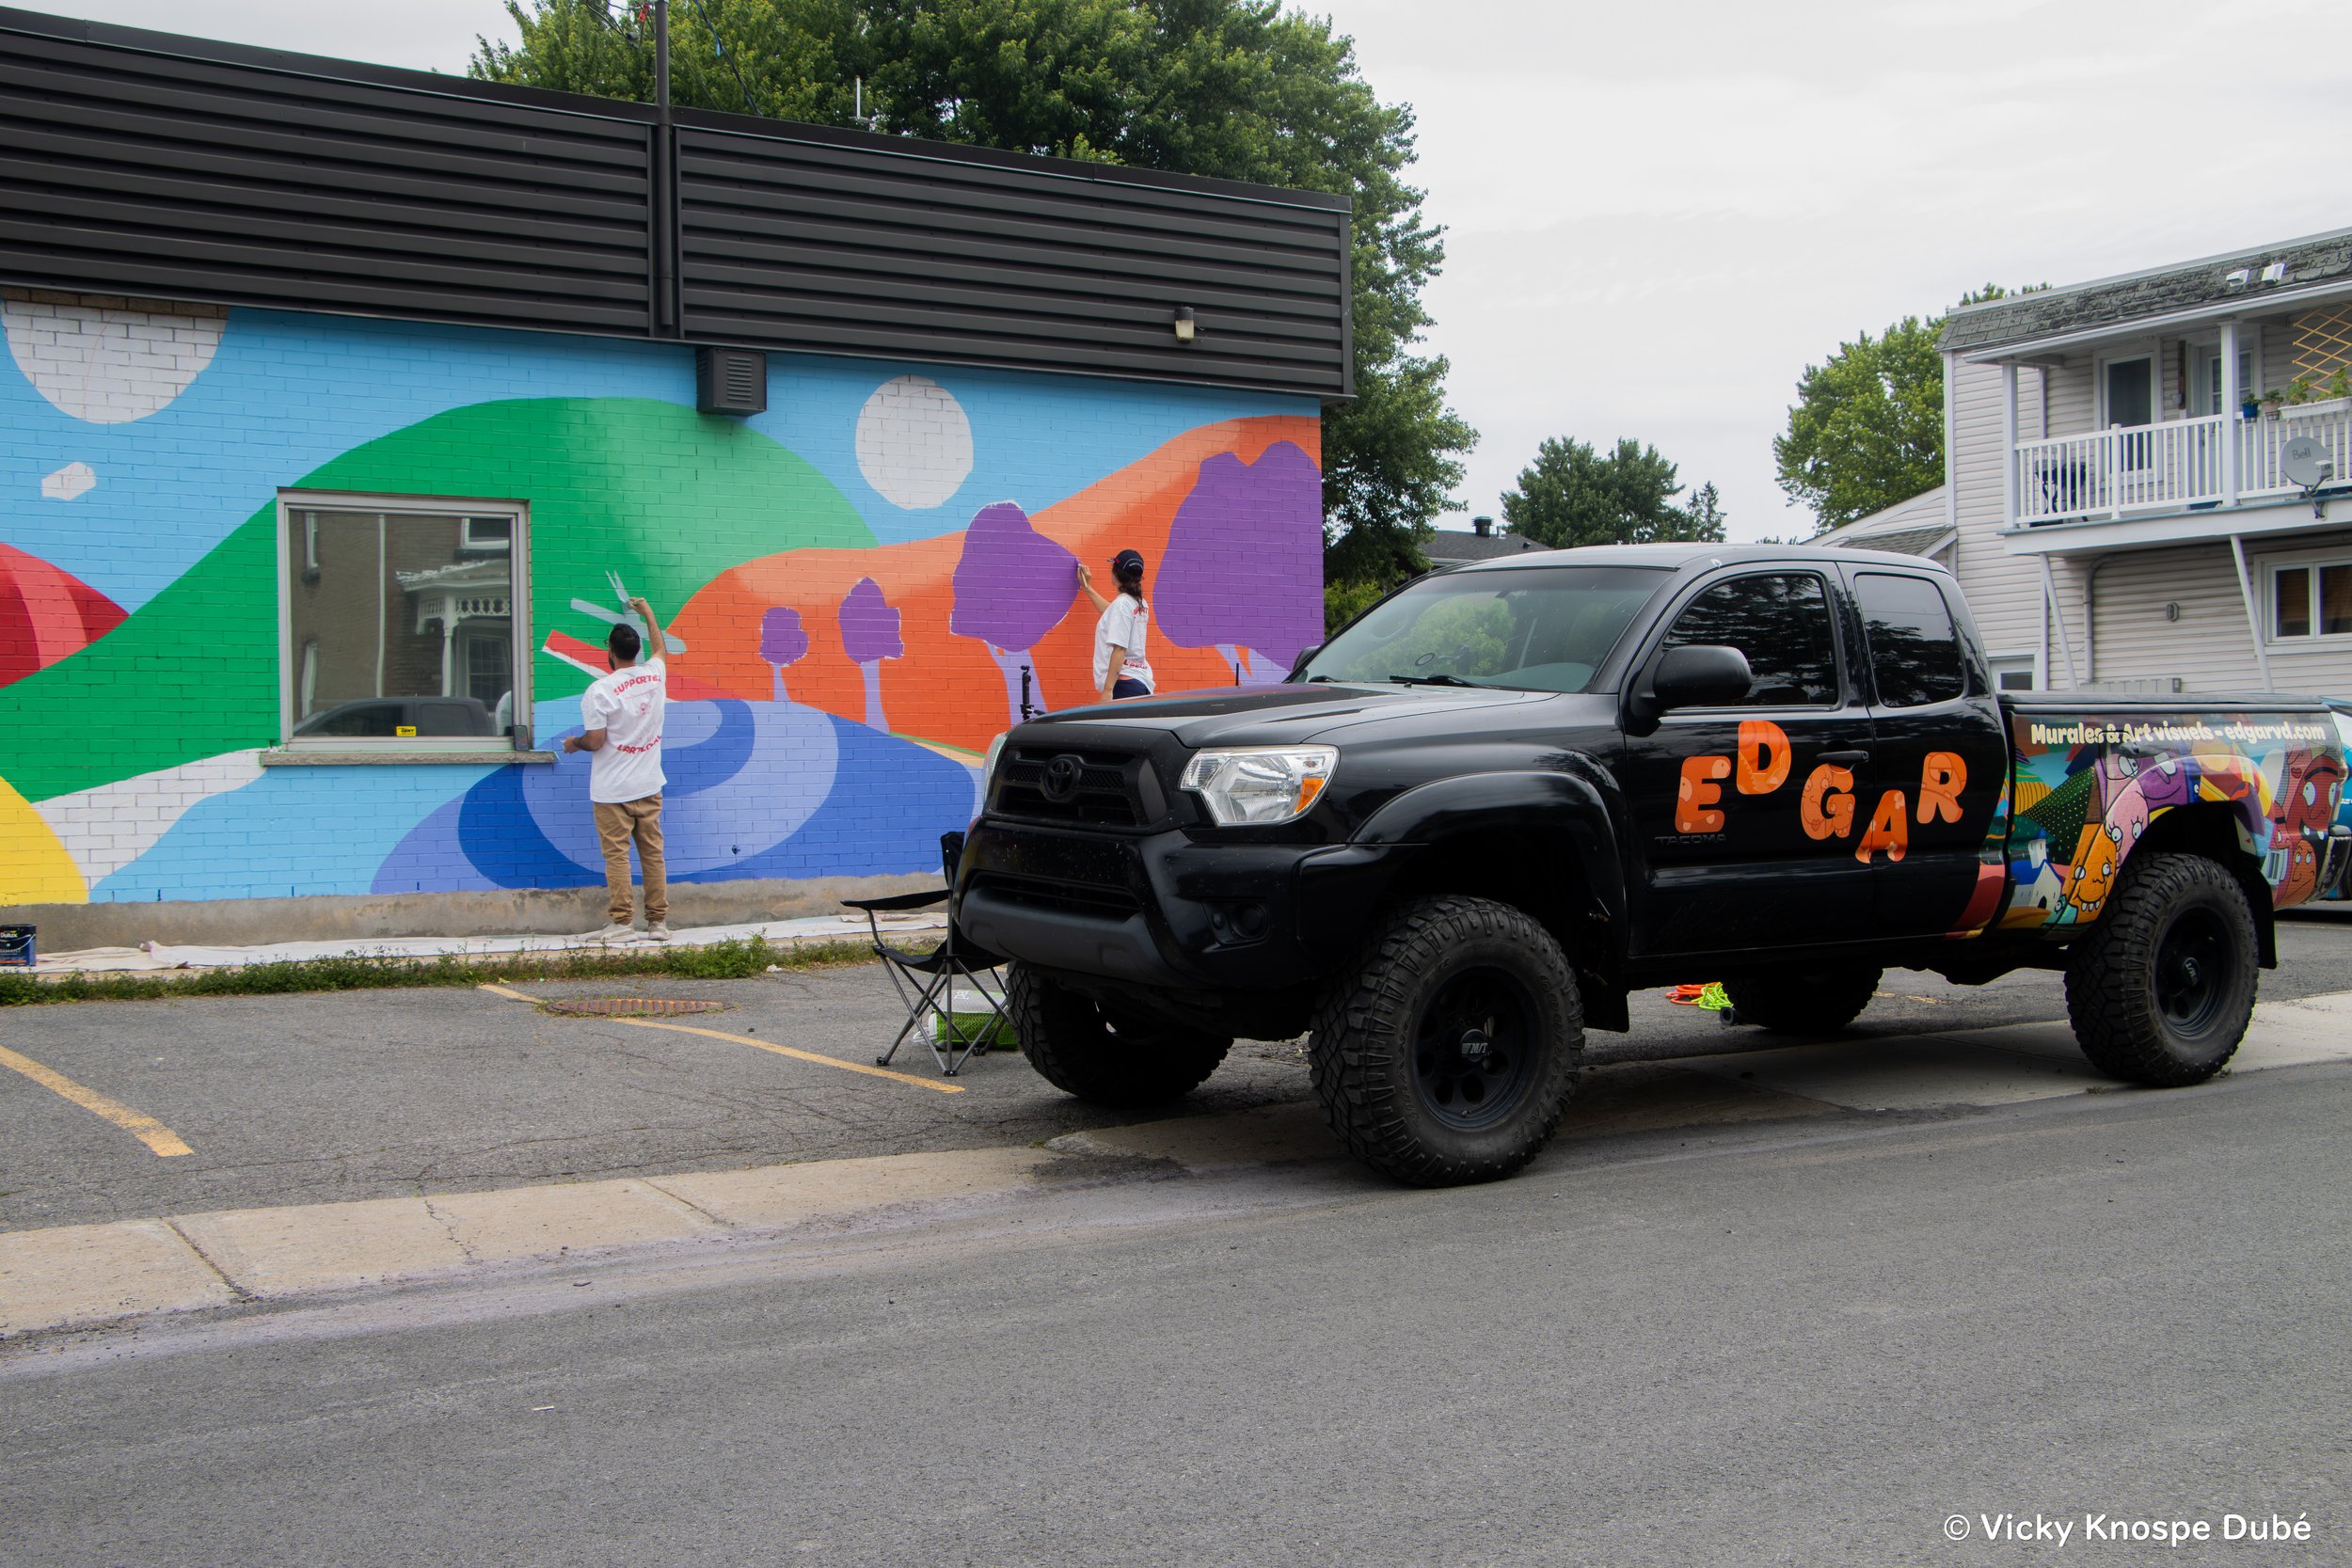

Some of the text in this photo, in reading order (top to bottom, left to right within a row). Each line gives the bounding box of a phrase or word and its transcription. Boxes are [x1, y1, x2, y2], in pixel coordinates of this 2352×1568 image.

[2292, 447, 2312, 460] Bell
[2031, 722, 2105, 744] Murales
[2106, 723, 2121, 744] &
[2122, 723, 2154, 743] Art
[2153, 721, 2214, 741] visuels
[2224, 721, 2327, 744] edgarvd.com
[1675, 720, 1967, 863] EDGAR
[1654, 833, 1727, 846] TACOMA
